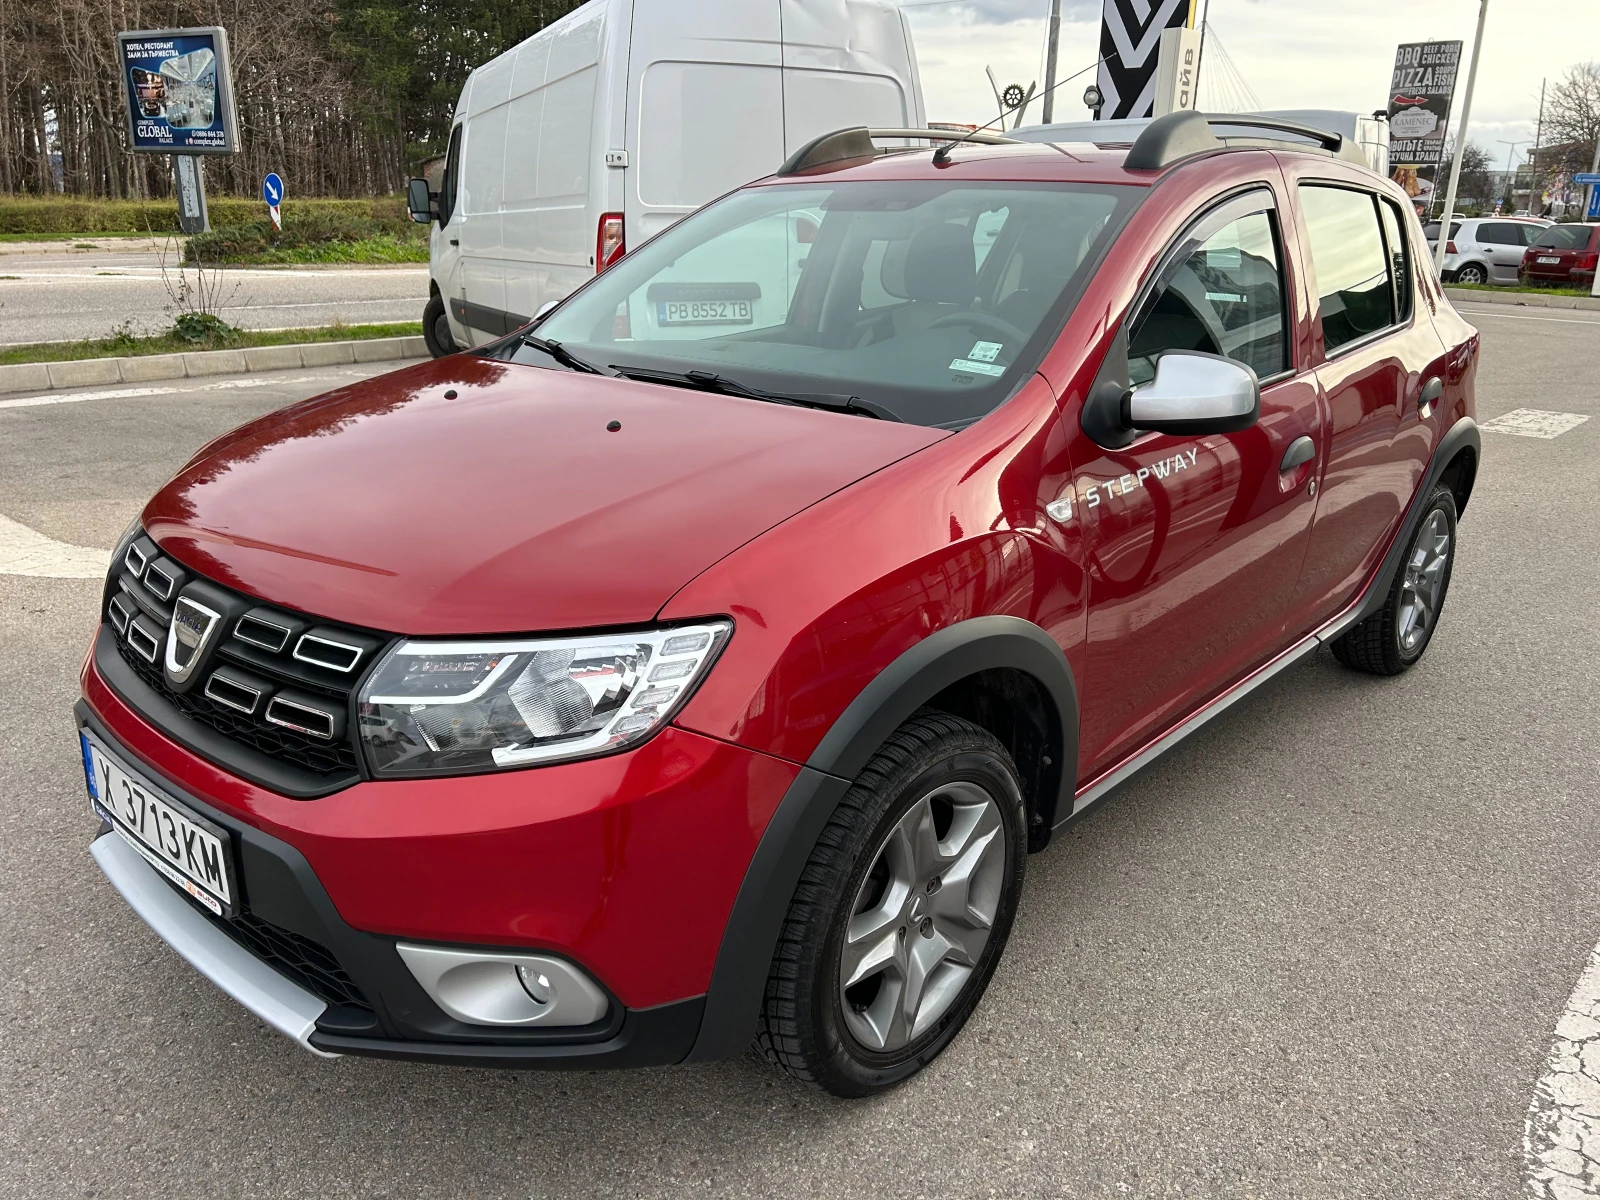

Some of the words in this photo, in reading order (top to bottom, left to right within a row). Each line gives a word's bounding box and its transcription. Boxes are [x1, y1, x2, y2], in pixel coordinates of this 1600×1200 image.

[144, 42, 174, 50] РЕСТОРАНТ
[1423, 45, 1439, 53] BEEF
[127, 51, 142, 59] ЗАЛИ
[1396, 46, 1421, 67] BBQ
[1421, 53, 1458, 64] CHICKEN
[1435, 66, 1456, 74] SOUPS
[1391, 67, 1433, 88] PIZZA
[1433, 74, 1454, 86] FISH
[1408, 86, 1427, 95] FRESH
[1427, 86, 1452, 95] SALADS
[1394, 117, 1433, 126] KAMENEC
[137, 125, 173, 138] GLOBAL
[1415, 151, 1439, 161] ХРАНА
[678, 289, 735, 297] MASTER
[668, 303, 689, 320] PB
[691, 302, 727, 318] 8552
[730, 302, 749, 317] TB
[1085, 447, 1198, 508] STEPWAY
[99, 757, 117, 811] X
